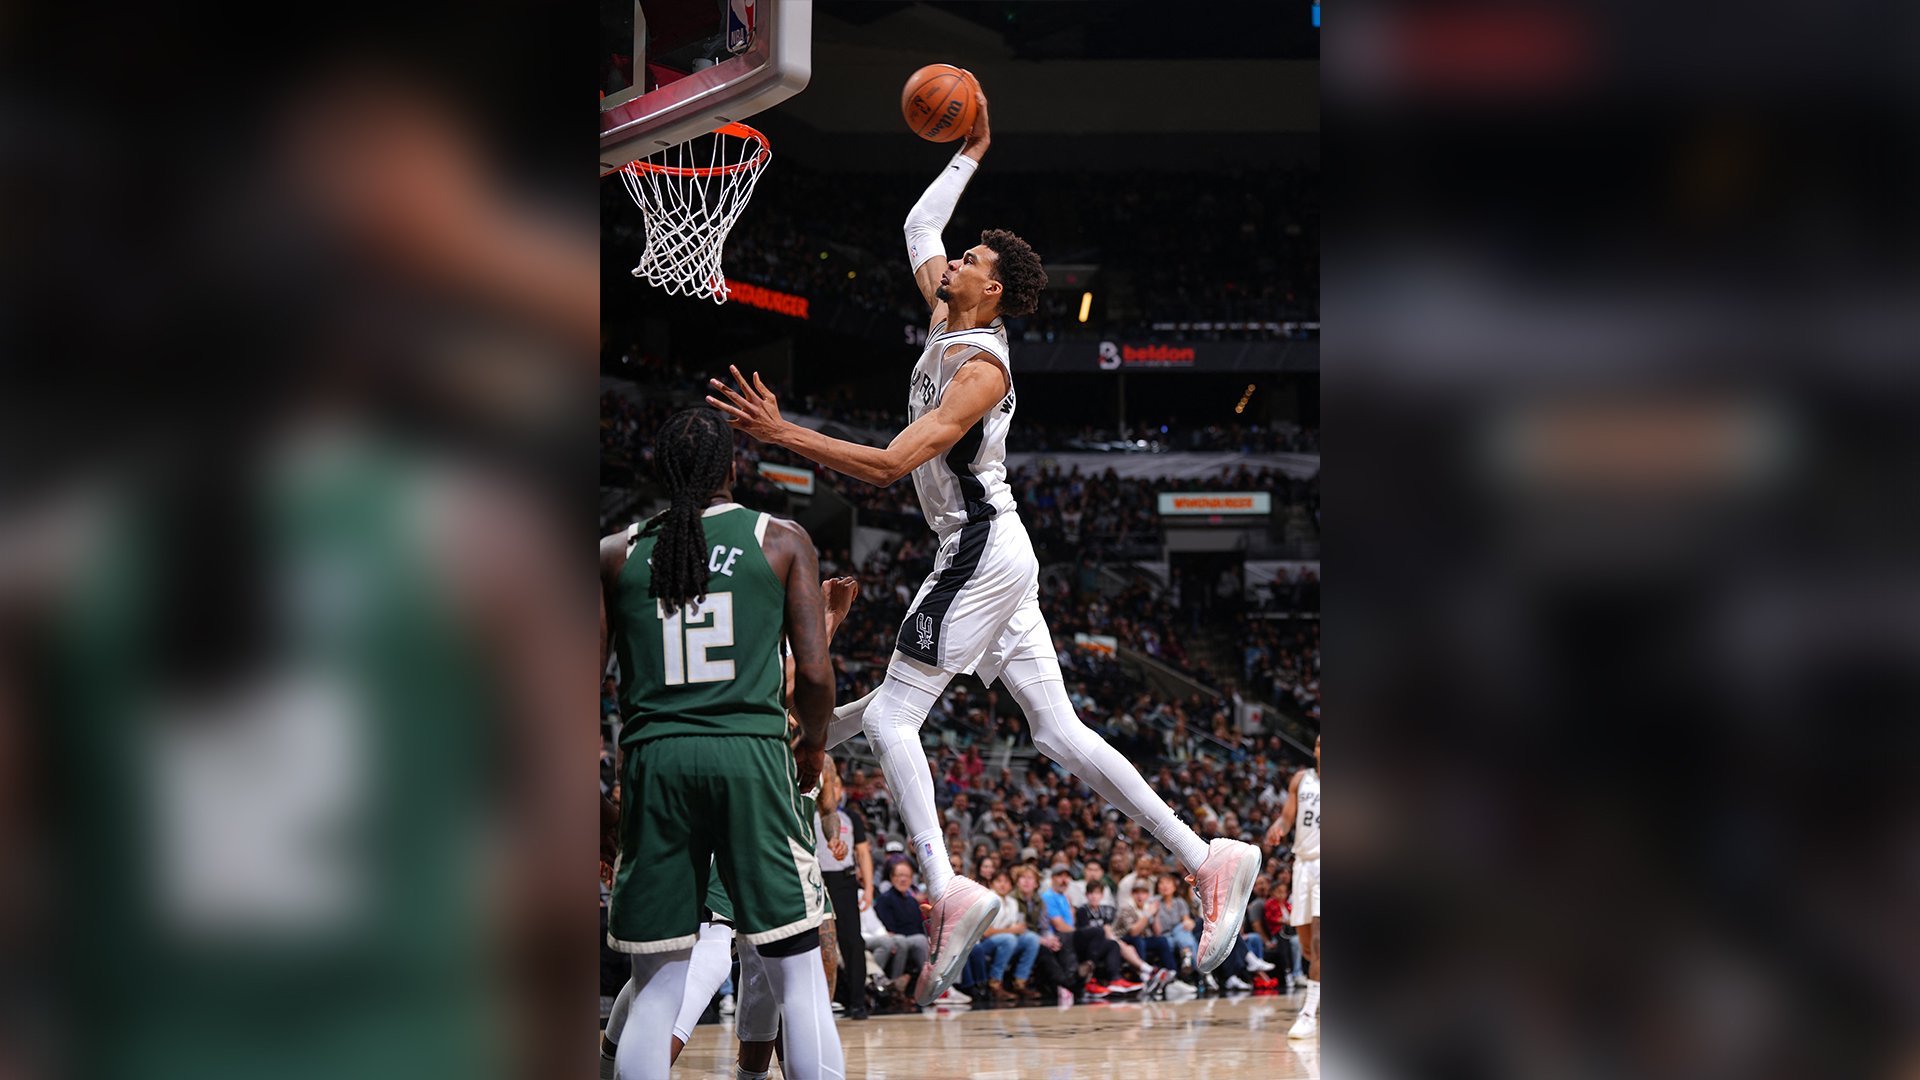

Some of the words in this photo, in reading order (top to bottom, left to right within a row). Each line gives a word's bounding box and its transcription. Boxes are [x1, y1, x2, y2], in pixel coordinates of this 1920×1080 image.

[925, 100, 962, 138] Wilson
[1123, 344, 1195, 363] beldon
[657, 592, 736, 686] 12
